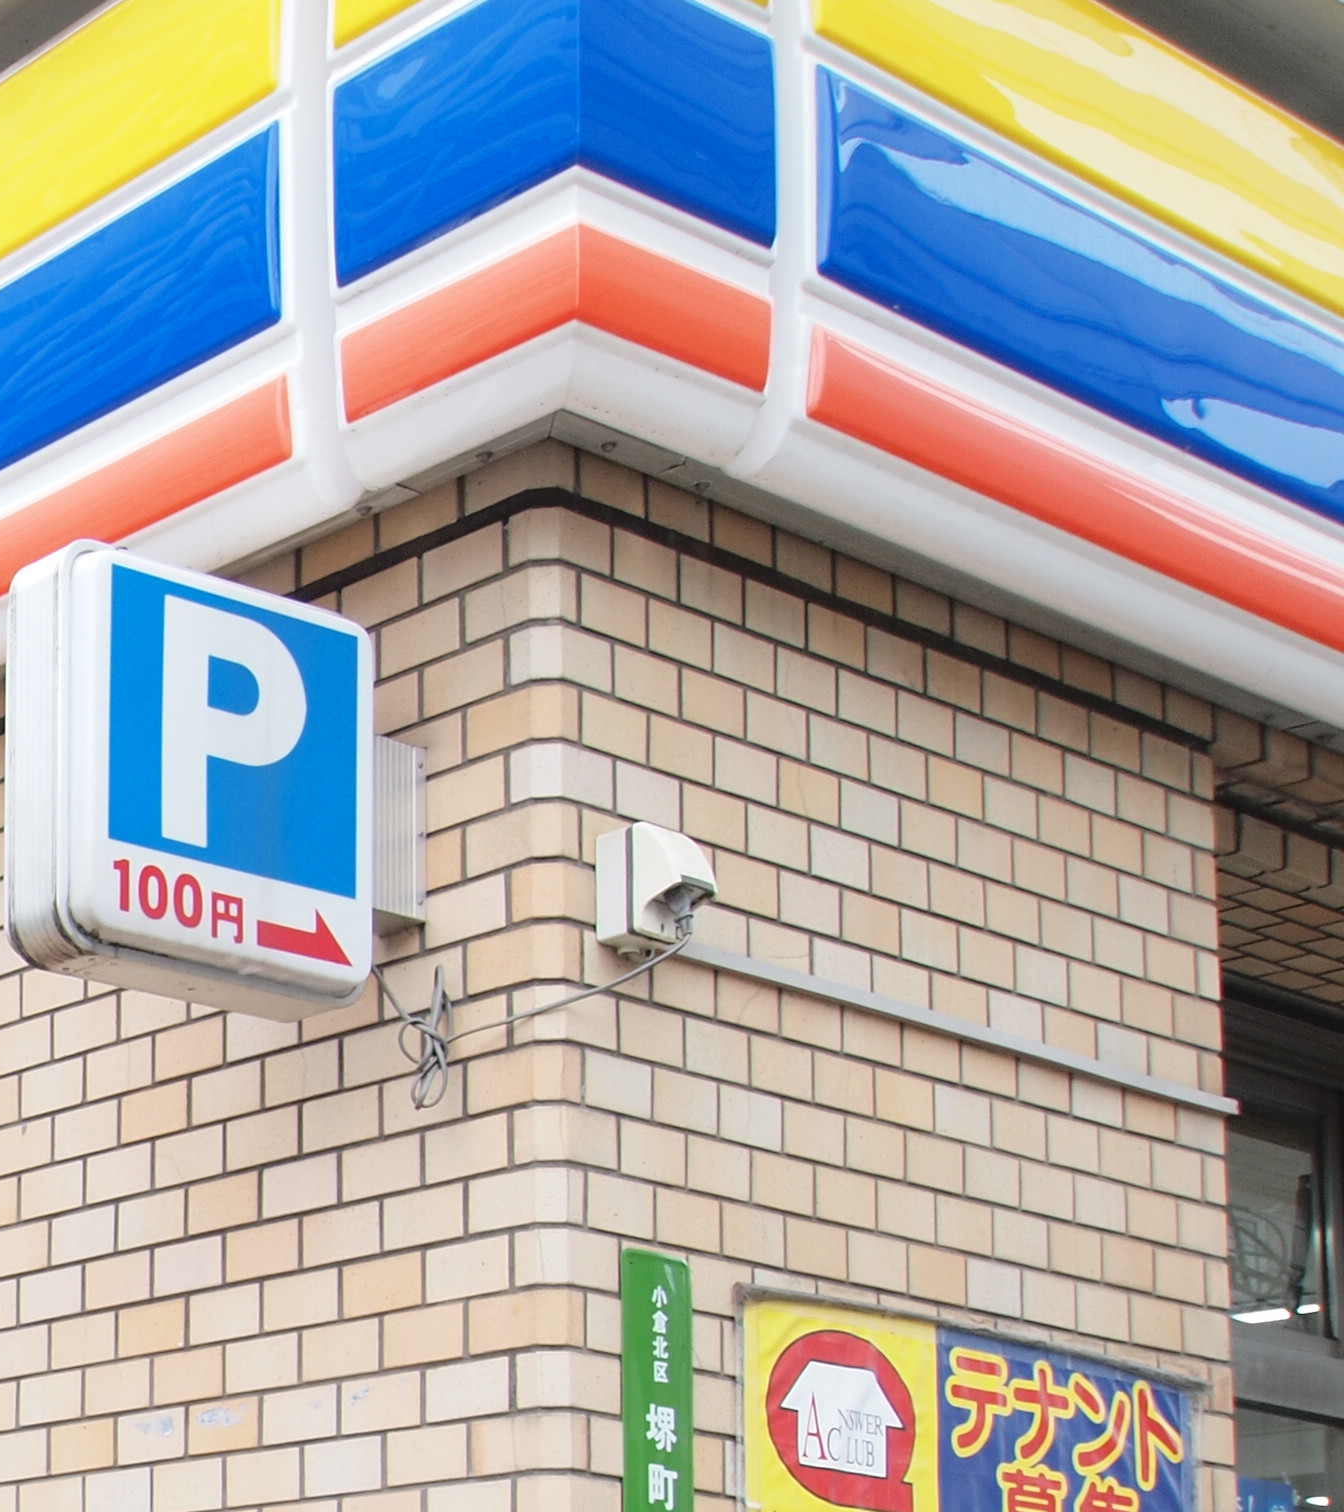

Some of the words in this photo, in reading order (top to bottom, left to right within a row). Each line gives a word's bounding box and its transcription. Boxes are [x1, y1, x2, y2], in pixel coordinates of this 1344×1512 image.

[161, 593, 308, 849] P
[112, 858, 245, 945] 100円
[650, 1285, 670, 1384] 小倉北区
[827, 1425, 876, 1468] CLUB
[946, 1345, 1183, 1490] テナント
